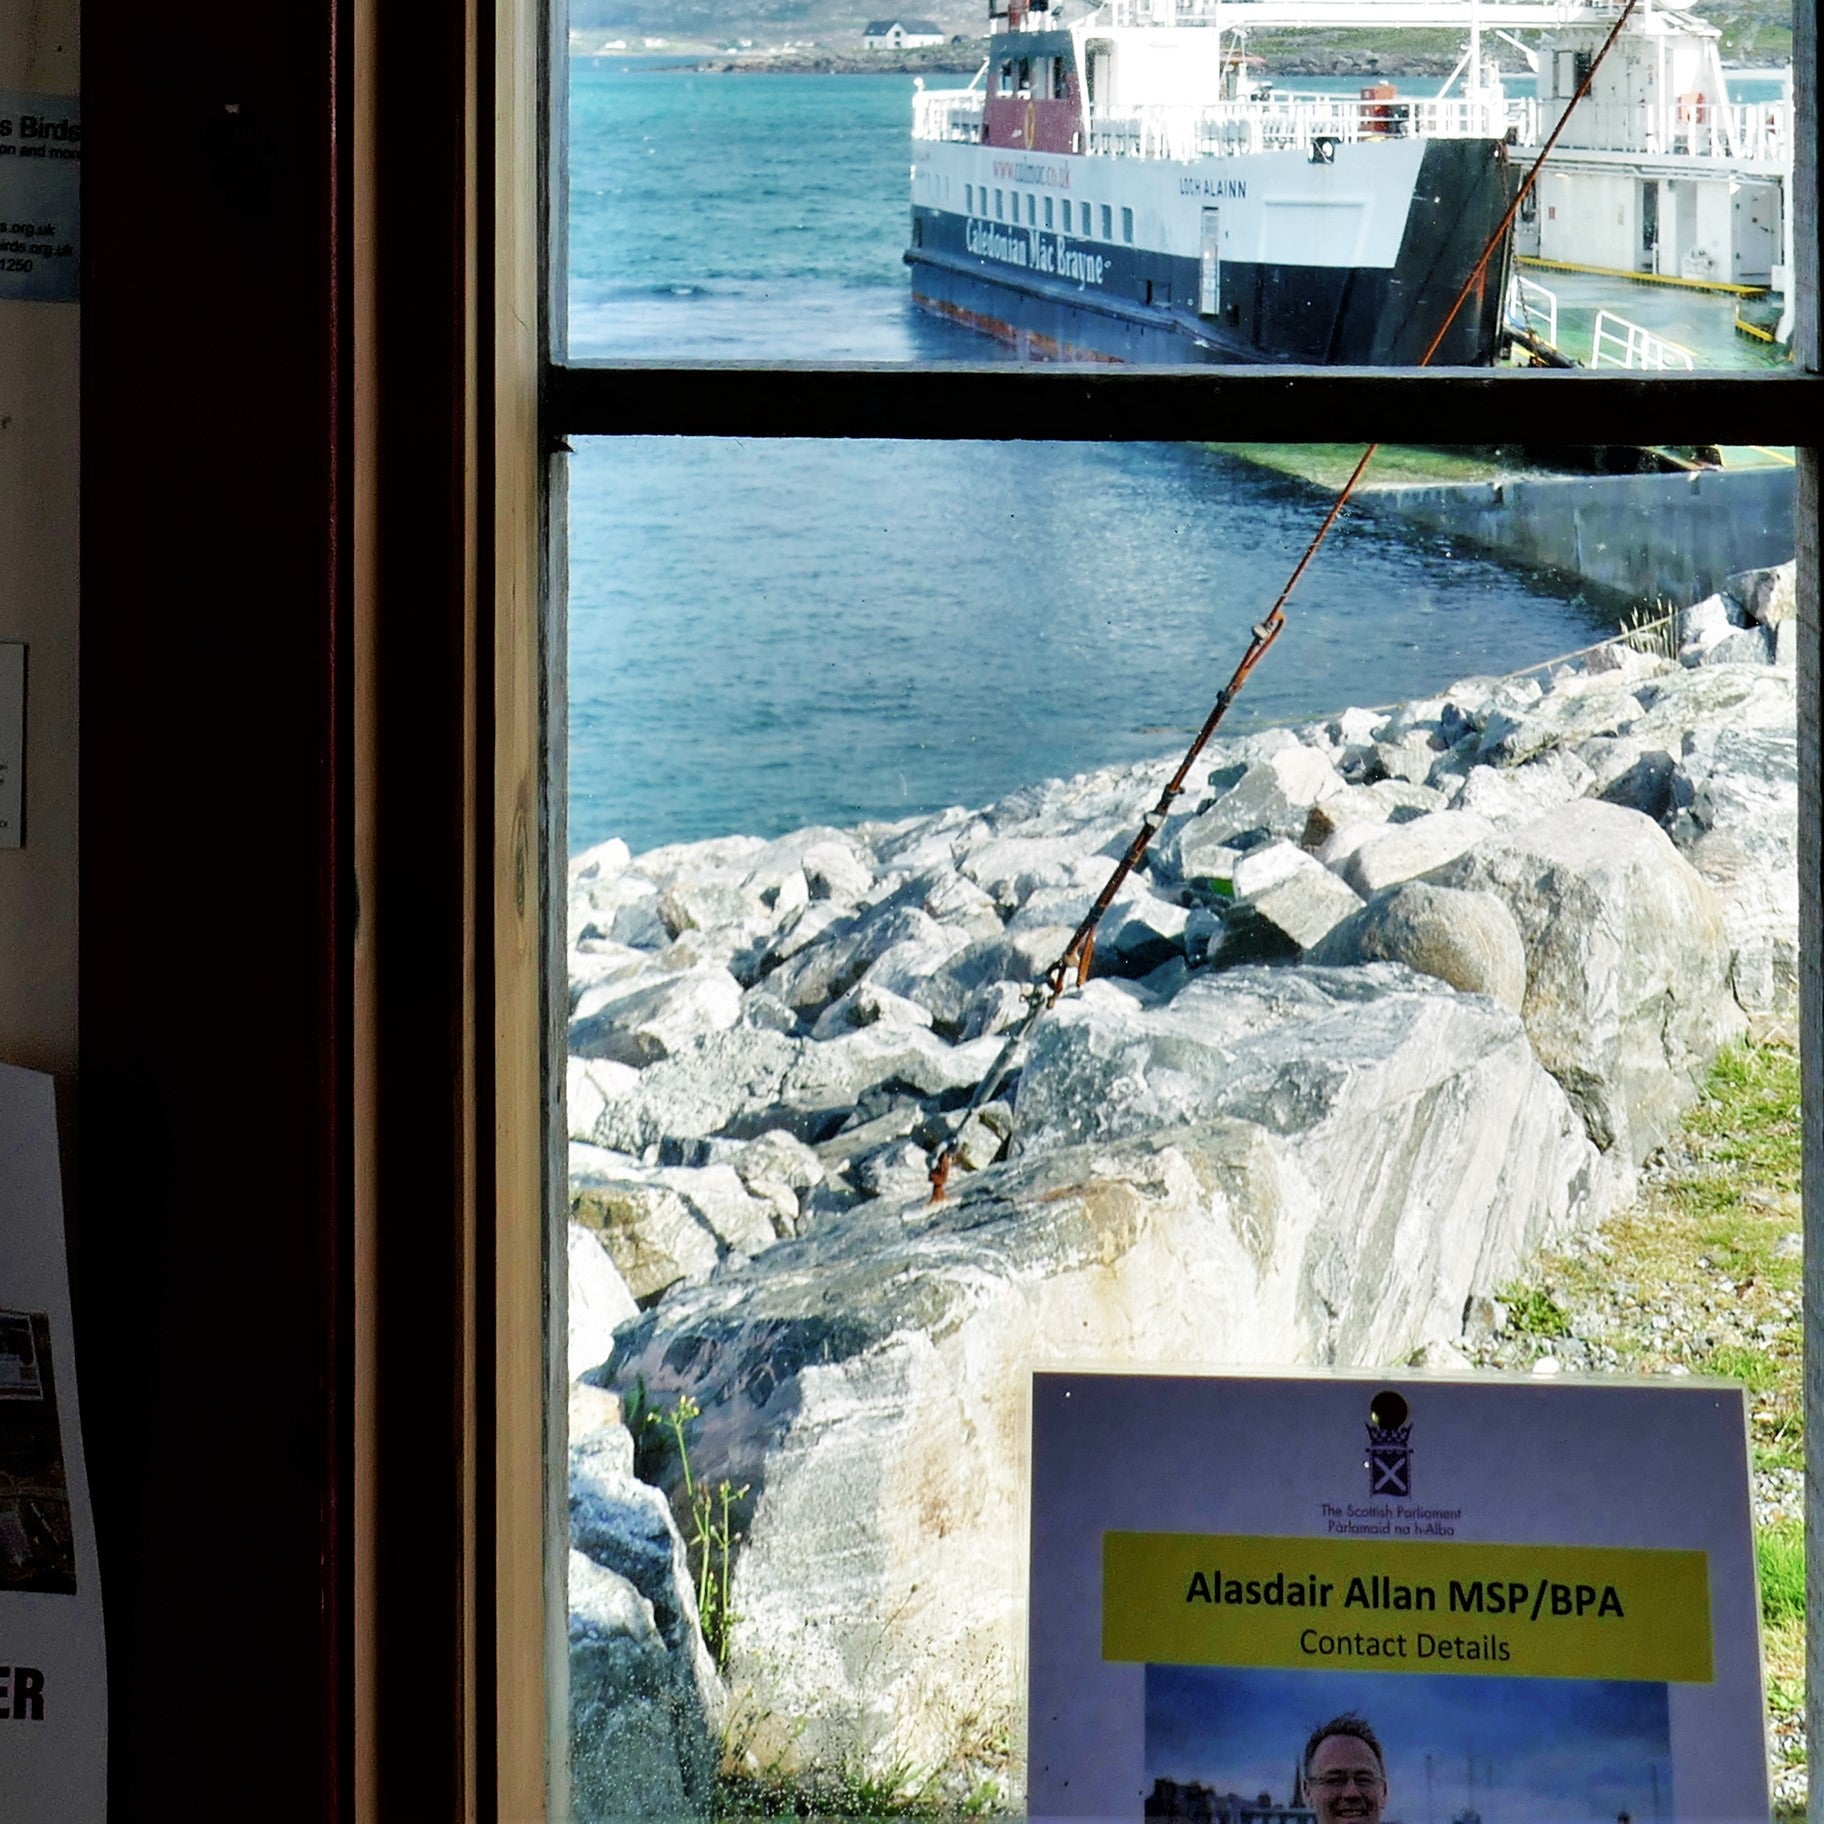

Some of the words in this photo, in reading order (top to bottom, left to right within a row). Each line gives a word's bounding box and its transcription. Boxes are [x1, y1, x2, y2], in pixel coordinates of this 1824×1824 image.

[20, 116, 83, 143] Birds
[20, 144, 47, 158] and
[1179, 177, 1201, 196] LOCH
[1203, 179, 1247, 199] ALAINN
[965, 218, 1026, 267] Caledonian
[1321, 1504, 1342, 1517] The
[1347, 1504, 1392, 1518] Scottish
[1397, 1505, 1462, 1520] Parliament
[1328, 1520, 1391, 1535] Pàrlamaid
[1395, 1525, 1411, 1535] na
[1414, 1523, 1455, 1536] h-Alba
[1185, 1570, 1334, 1608] Alasdair
[1344, 1574, 1437, 1611] Allan
[1448, 1578, 1625, 1621] MSP/BPA
[1299, 1628, 1407, 1659] Contact
[1417, 1632, 1511, 1662] Details
